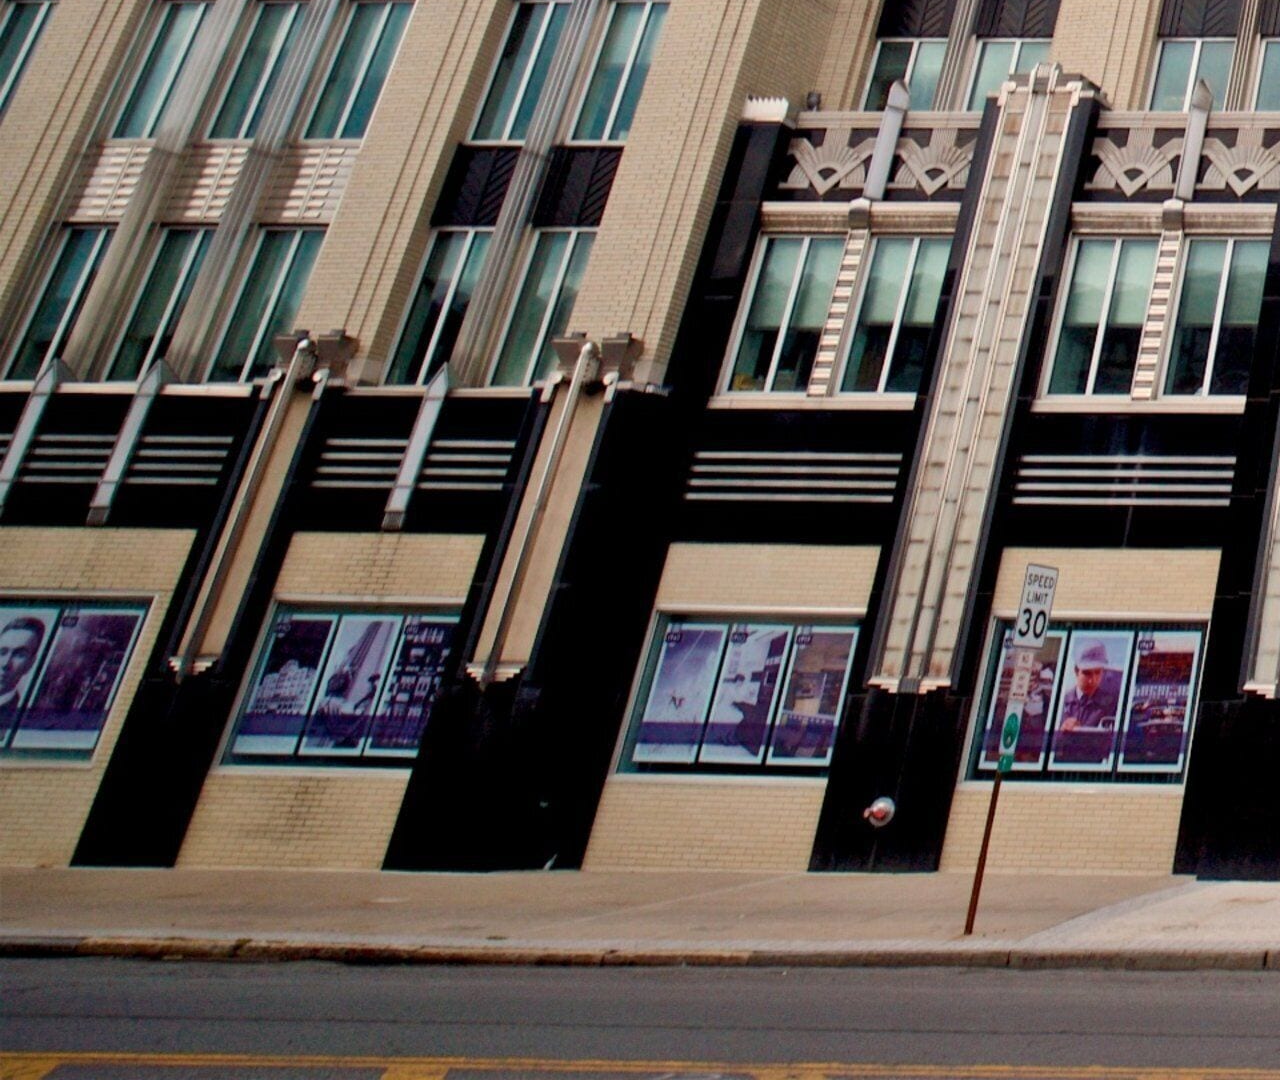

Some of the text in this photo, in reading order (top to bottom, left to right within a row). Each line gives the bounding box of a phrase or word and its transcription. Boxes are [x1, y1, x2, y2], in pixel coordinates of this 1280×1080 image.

[1028, 573, 1054, 589] SPEED
[1027, 592, 1048, 605] LIMIT
[1018, 608, 1046, 638] 30
